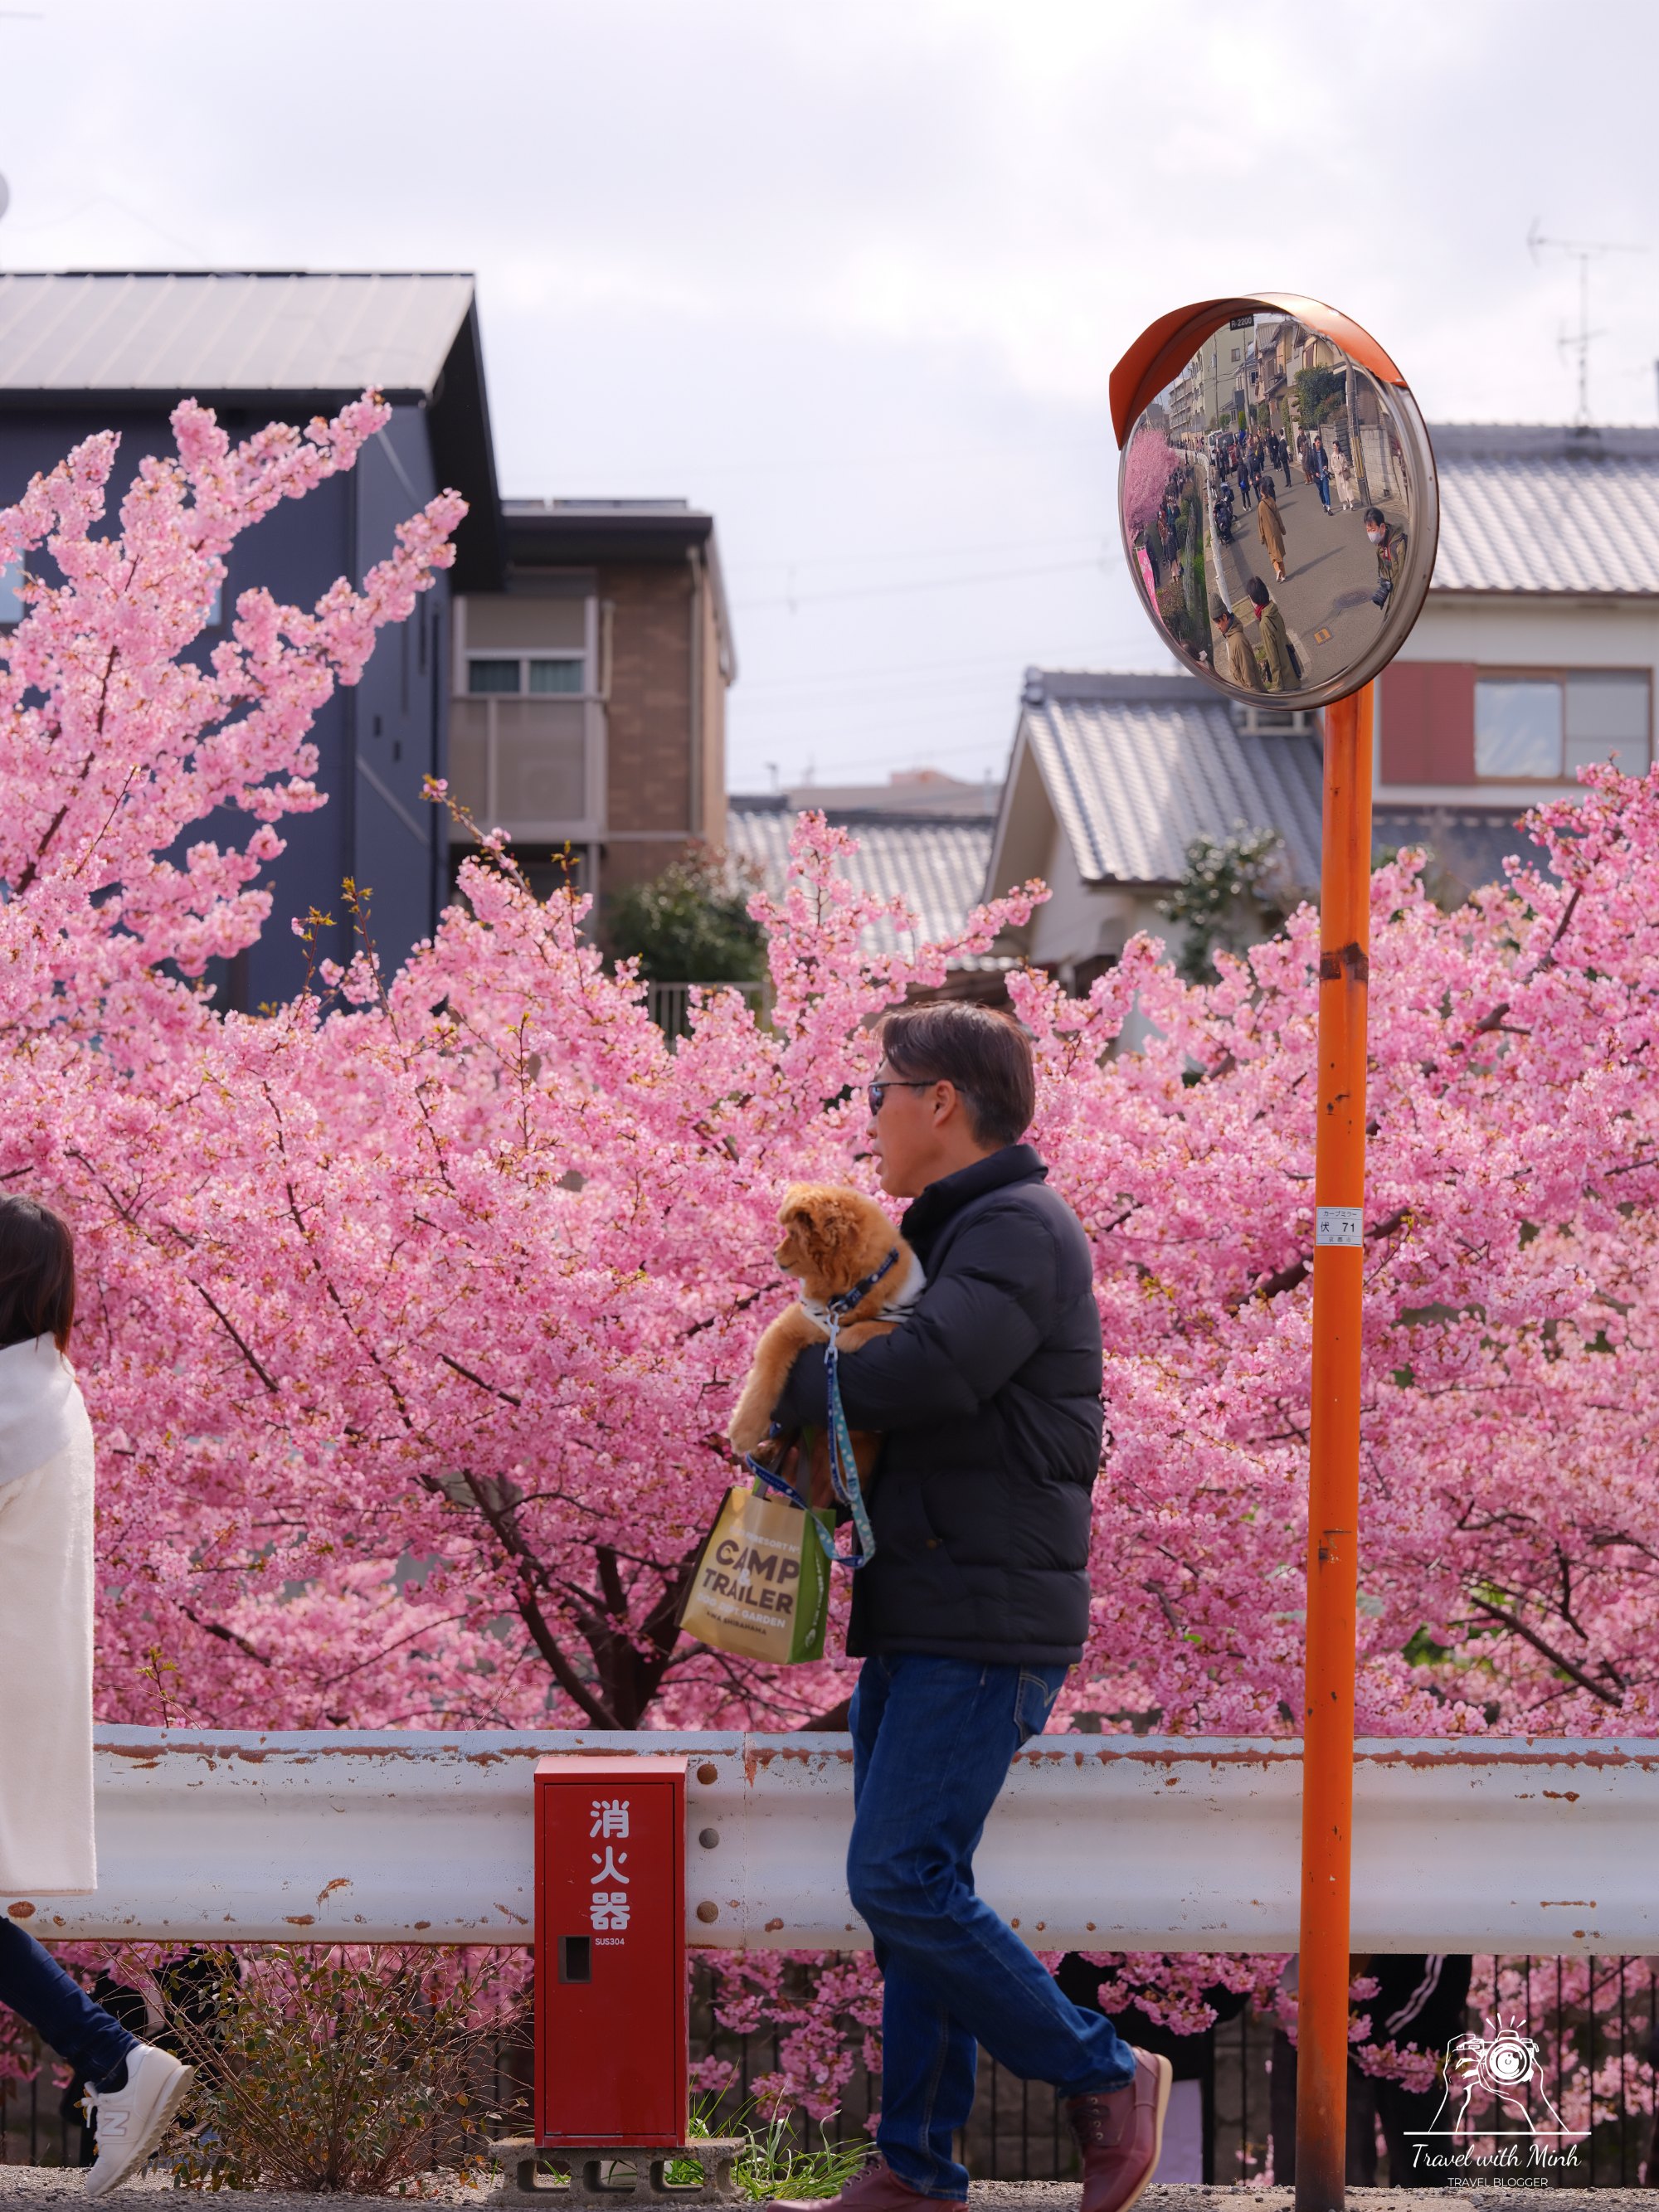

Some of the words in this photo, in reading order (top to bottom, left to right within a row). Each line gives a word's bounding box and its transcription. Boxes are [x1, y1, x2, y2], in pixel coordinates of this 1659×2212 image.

[1321, 1221, 1330, 1232] 伏
[1342, 1223, 1355, 1232] 71
[716, 1539, 800, 1584] CAMP
[737, 1568, 751, 1587] &
[703, 1568, 793, 1615] TRAILER
[742, 1610, 786, 1628] GARDEN
[590, 1799, 630, 1930] 消火器
[595, 1937, 625, 1946] SUS304
